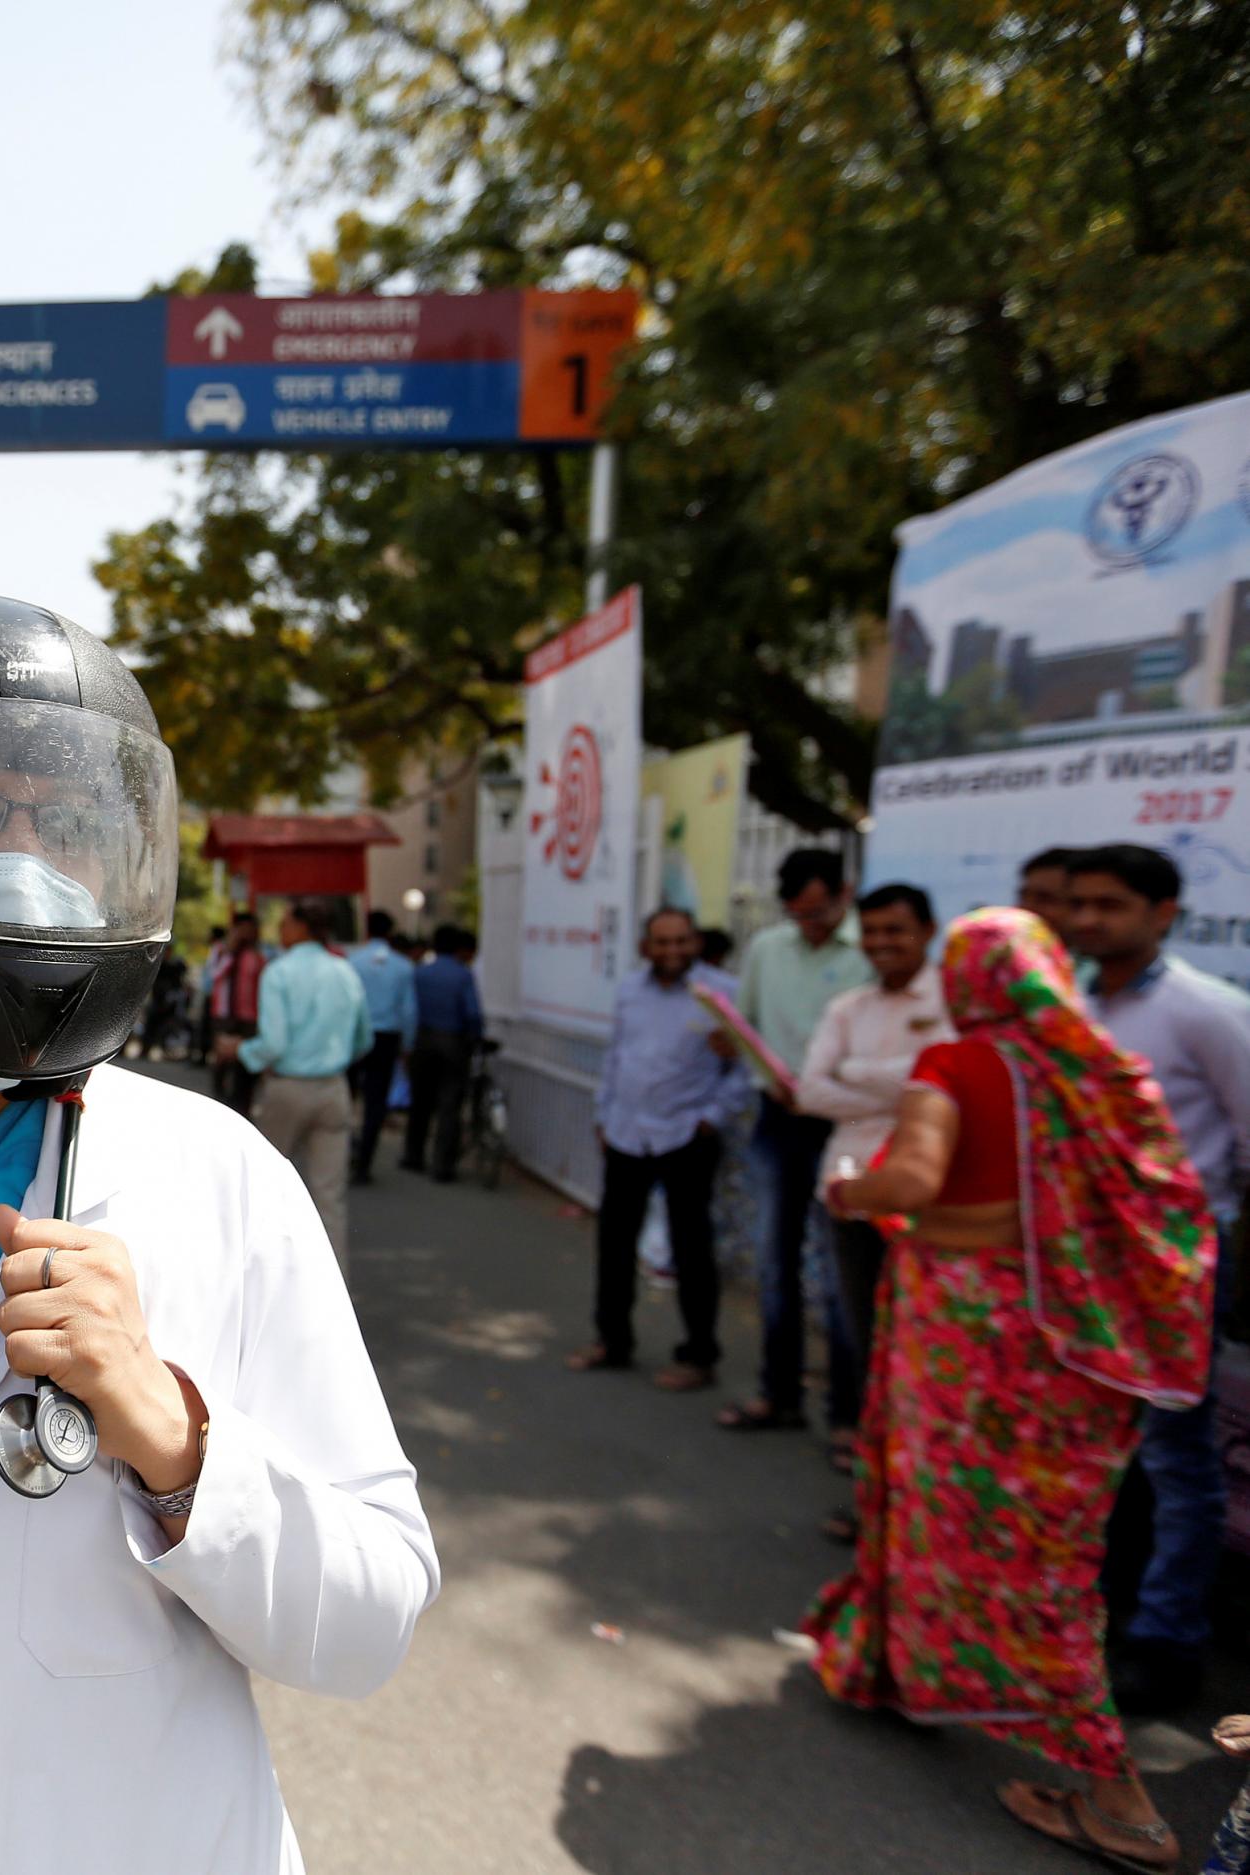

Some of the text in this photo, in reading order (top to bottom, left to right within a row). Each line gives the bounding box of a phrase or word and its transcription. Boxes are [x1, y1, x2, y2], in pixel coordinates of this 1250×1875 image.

[273, 332, 419, 362] EMERGENCY
[561, 354, 588, 418] 1
[271, 405, 455, 435] VEHICLE ENTRY
[878, 764, 1048, 804] Celebration
[1057, 753, 1097, 787] of
[1104, 737, 1239, 780] World
[1134, 786, 1235, 826] 2017
